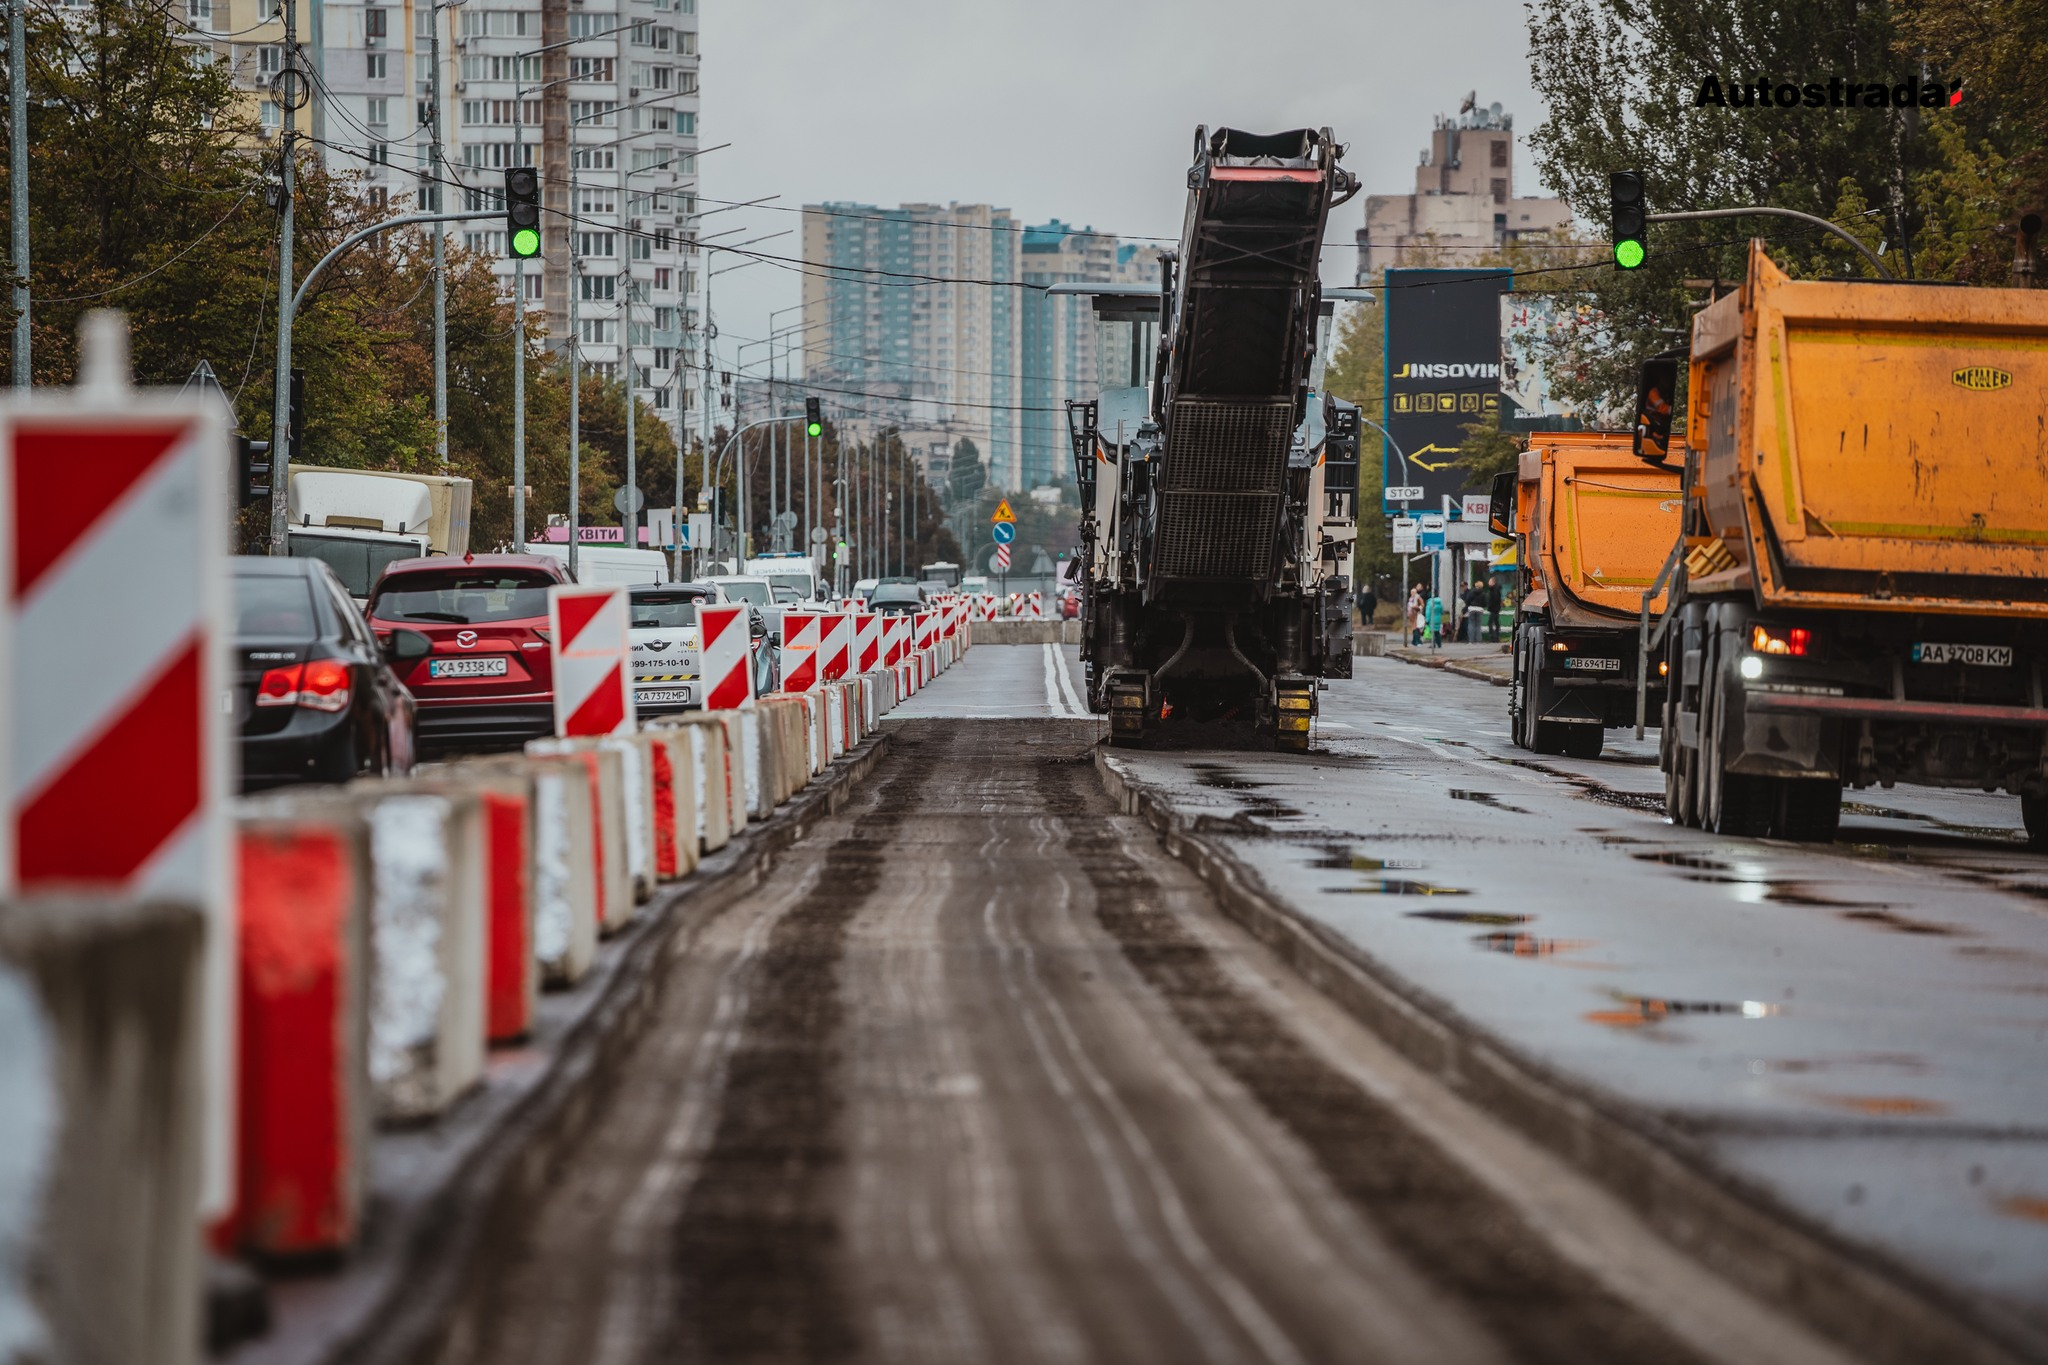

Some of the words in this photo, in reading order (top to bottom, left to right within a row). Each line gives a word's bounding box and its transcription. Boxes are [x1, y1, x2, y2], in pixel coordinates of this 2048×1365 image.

[1955, 368, 2010, 388] MEILLER
[1390, 488, 1419, 498] STOP
[1466, 503, 1490, 514] КВІ
[577, 529, 618, 540] КВІТИ
[459, 661, 485, 672] 9338
